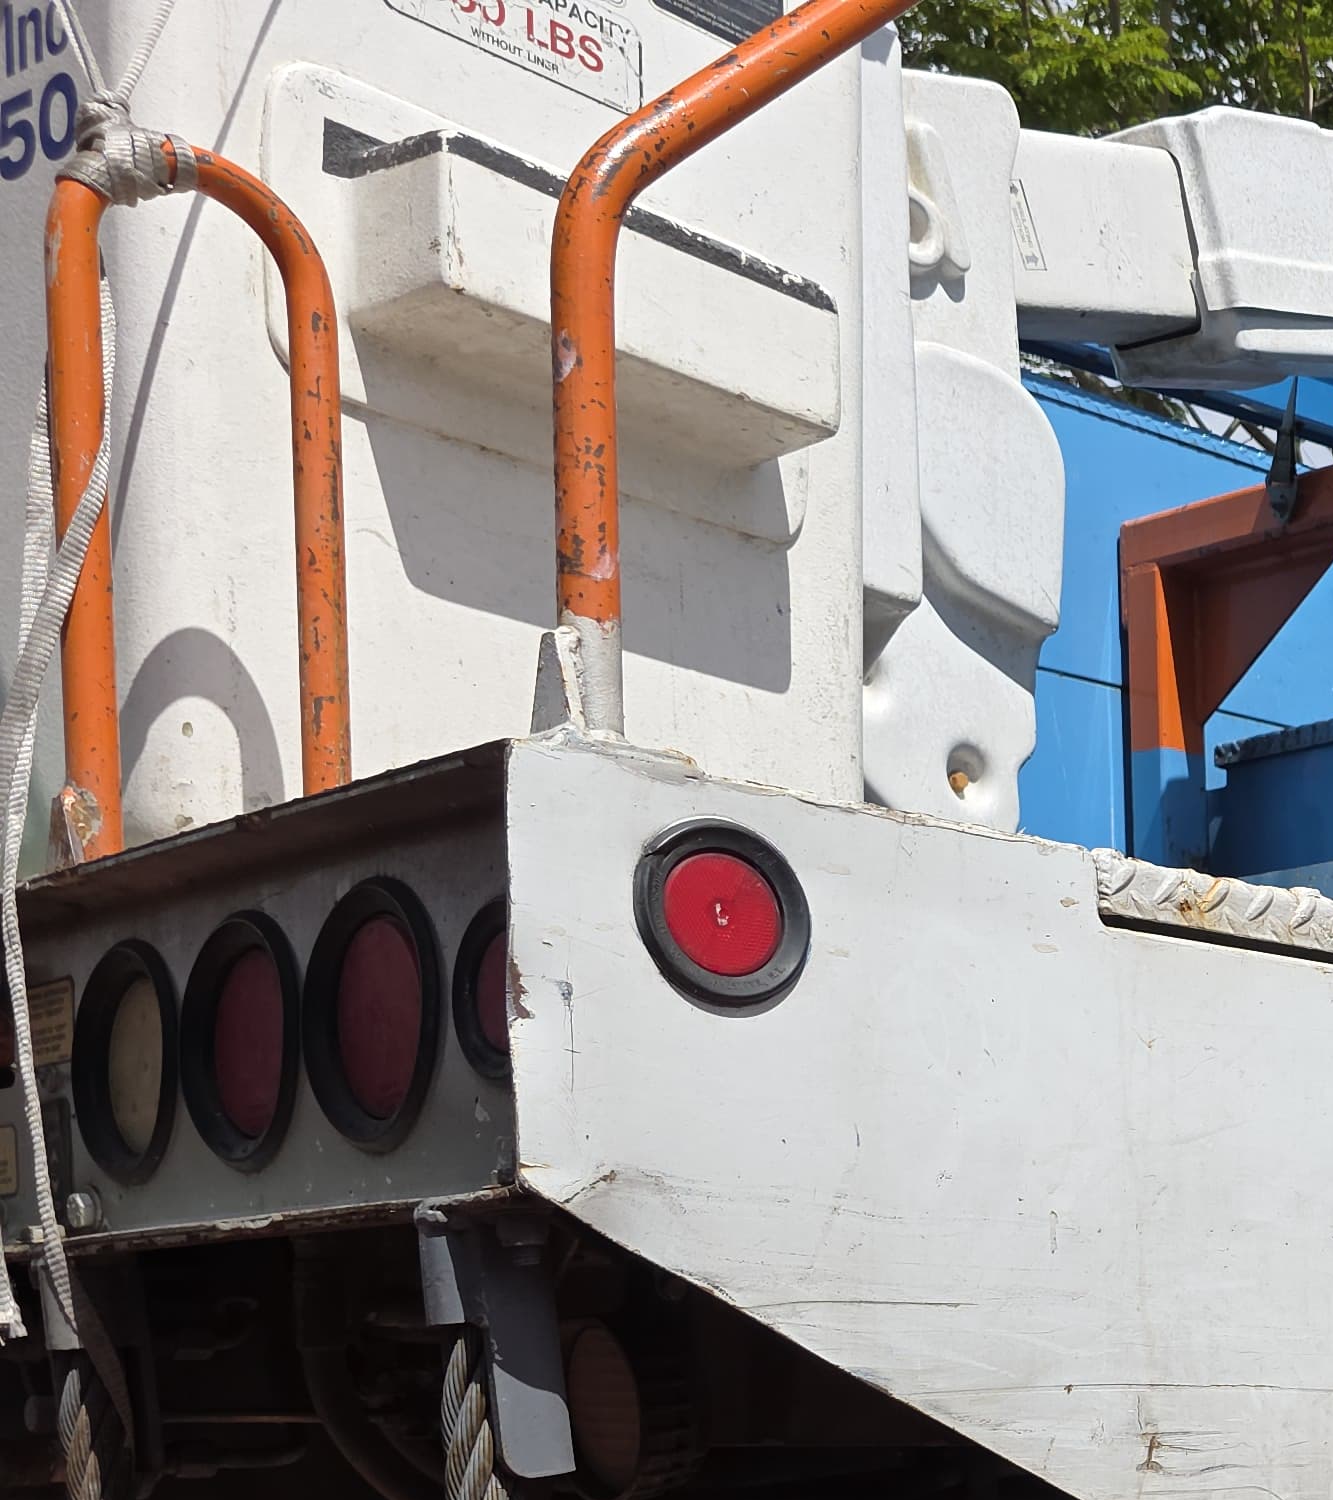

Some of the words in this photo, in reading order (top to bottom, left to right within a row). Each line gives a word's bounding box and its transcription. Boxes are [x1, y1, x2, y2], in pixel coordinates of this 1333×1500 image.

[470, 25, 524, 58] WITHOUT
[526, 51, 560, 75] LINER
[526, 7, 604, 73] LBS
